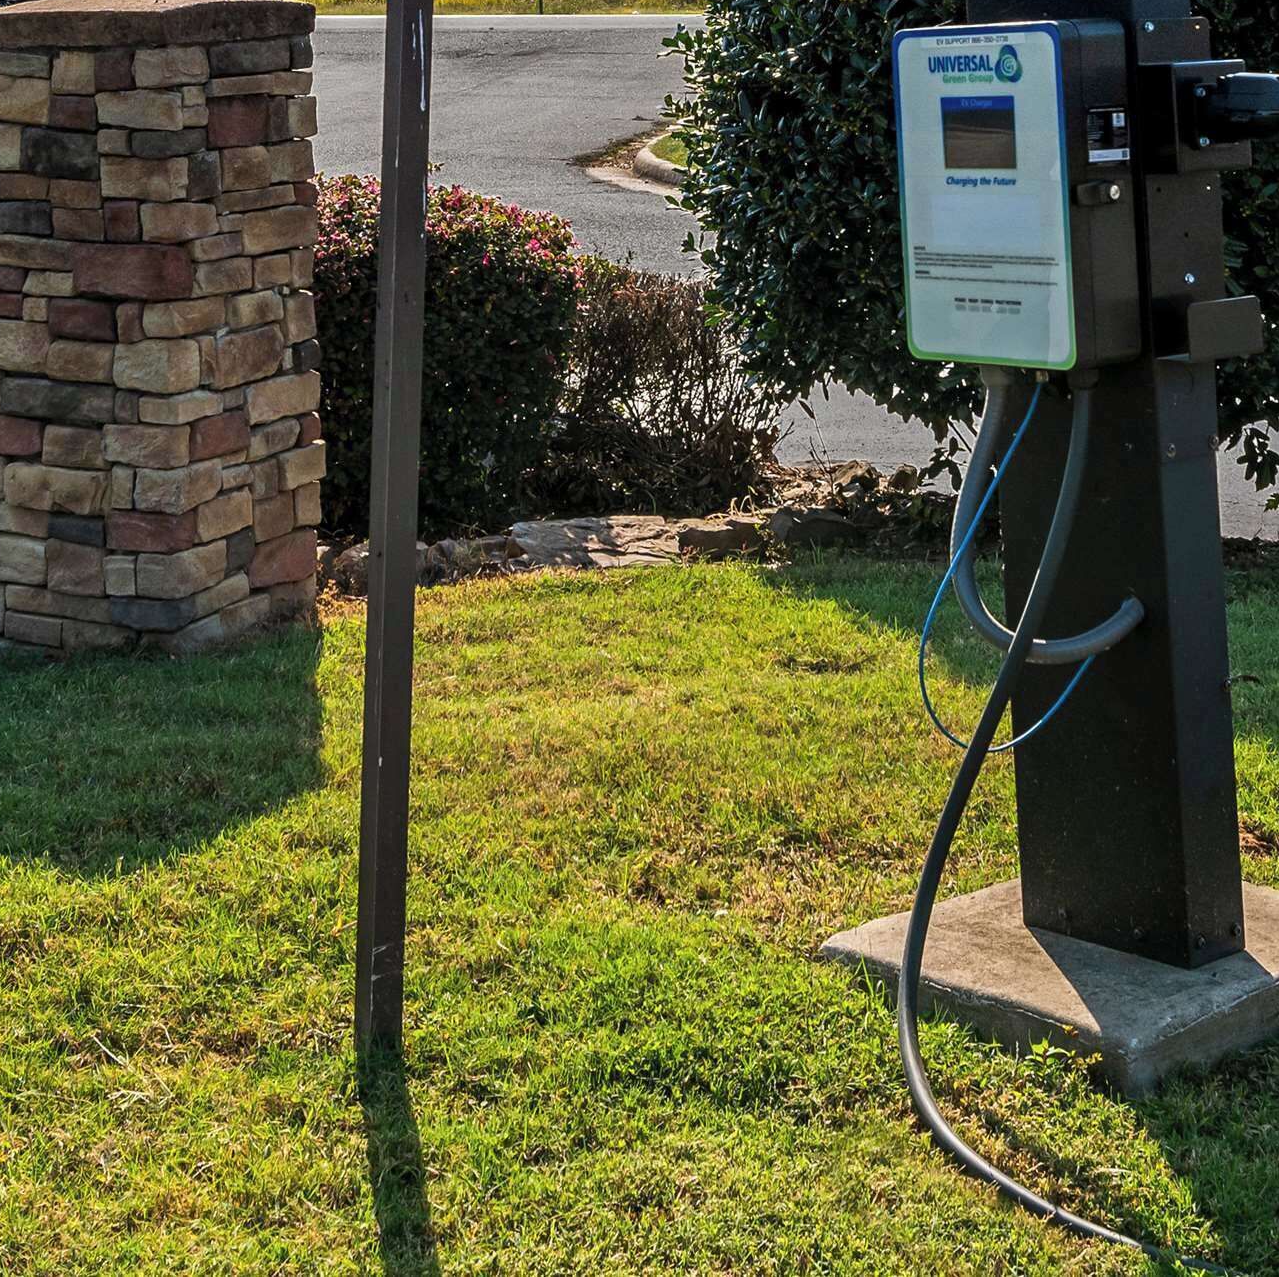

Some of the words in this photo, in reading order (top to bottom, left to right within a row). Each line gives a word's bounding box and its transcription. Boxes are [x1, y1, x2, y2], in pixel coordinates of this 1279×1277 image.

[945, 37, 971, 45] SUPPORT
[928, 54, 993, 73] UNIVERSAL
[943, 74, 967, 83] Green
[968, 74, 994, 84] Group
[945, 176, 978, 187] Charging
[979, 176, 992, 185] the
[992, 177, 1017, 186] Future
